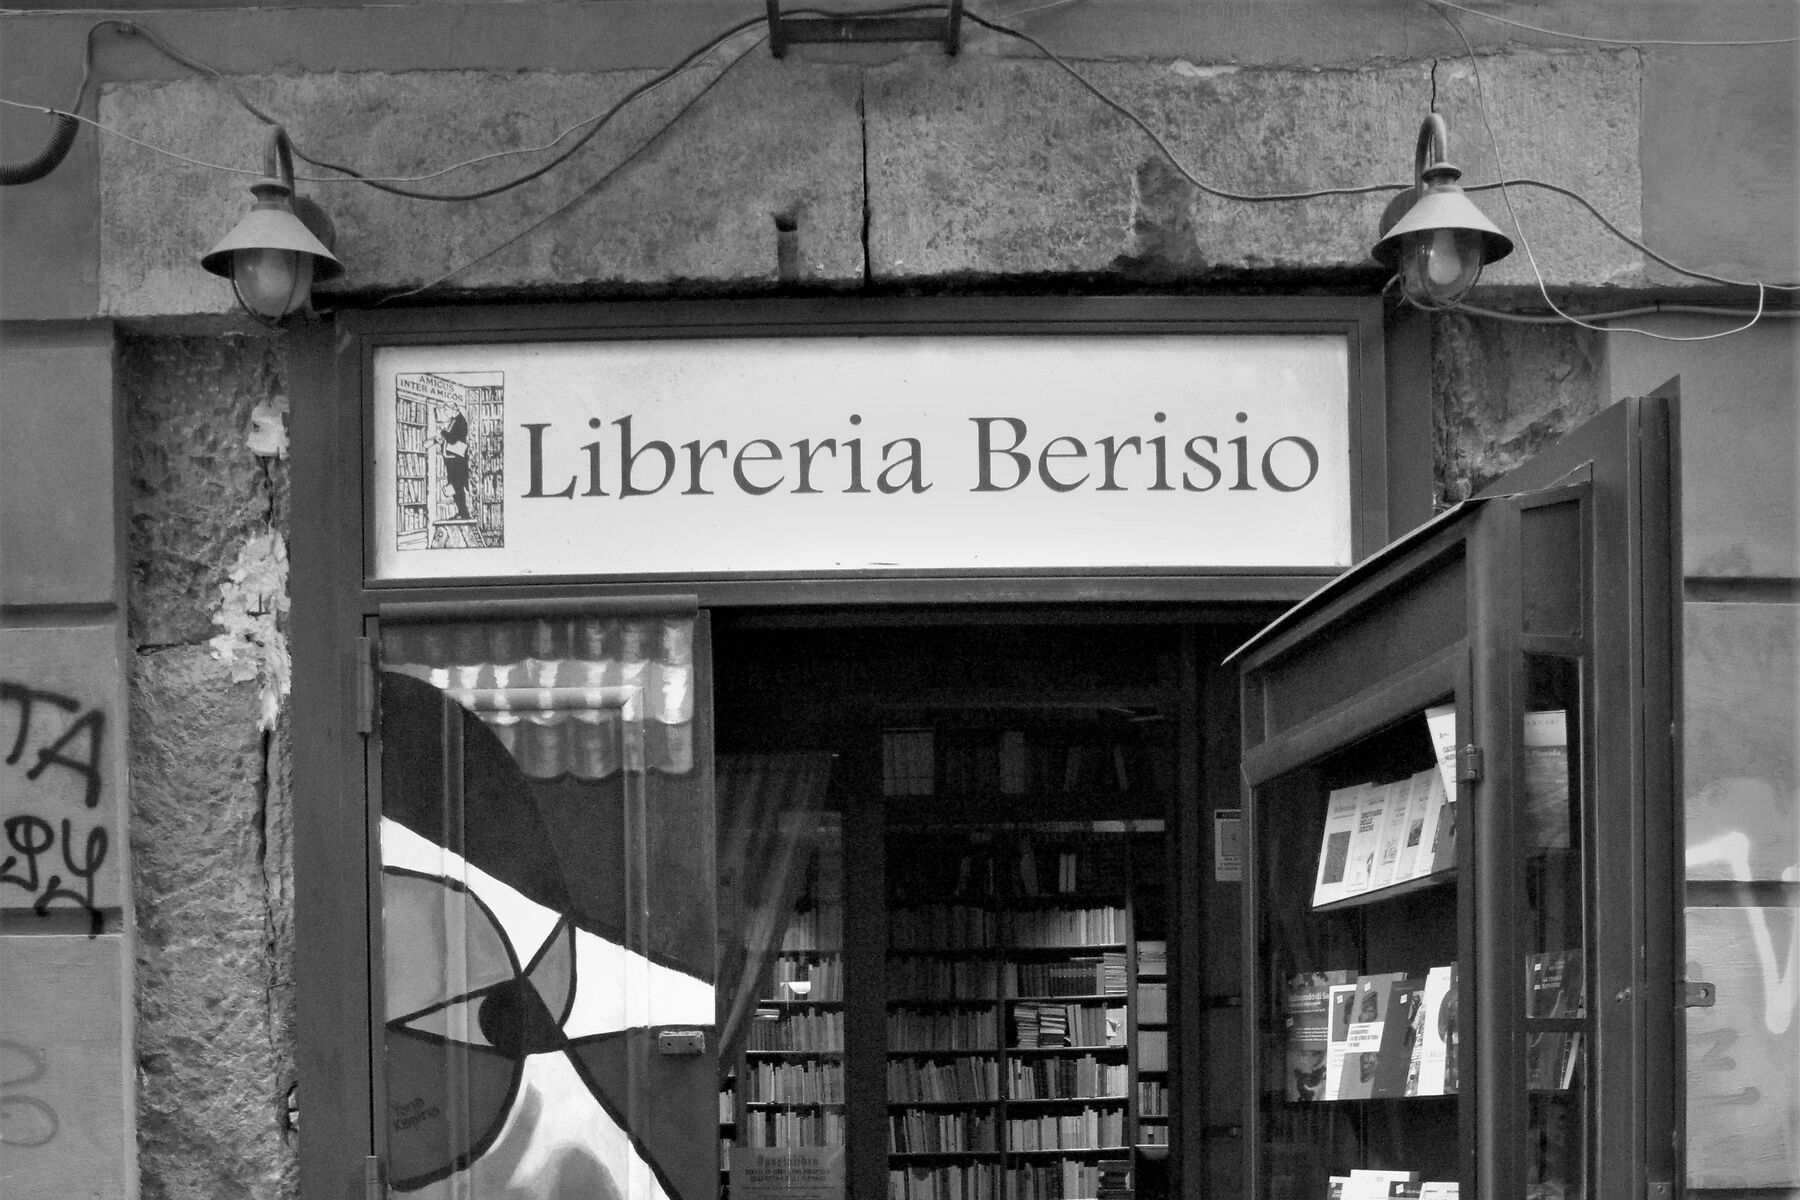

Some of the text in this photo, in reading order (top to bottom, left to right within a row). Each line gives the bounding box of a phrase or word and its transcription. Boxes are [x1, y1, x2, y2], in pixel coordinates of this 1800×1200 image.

[400, 379, 463, 402] INTER AMICOS
[419, 375, 455, 392] AMICUS
[520, 412, 1319, 500] Libreria Berisio
